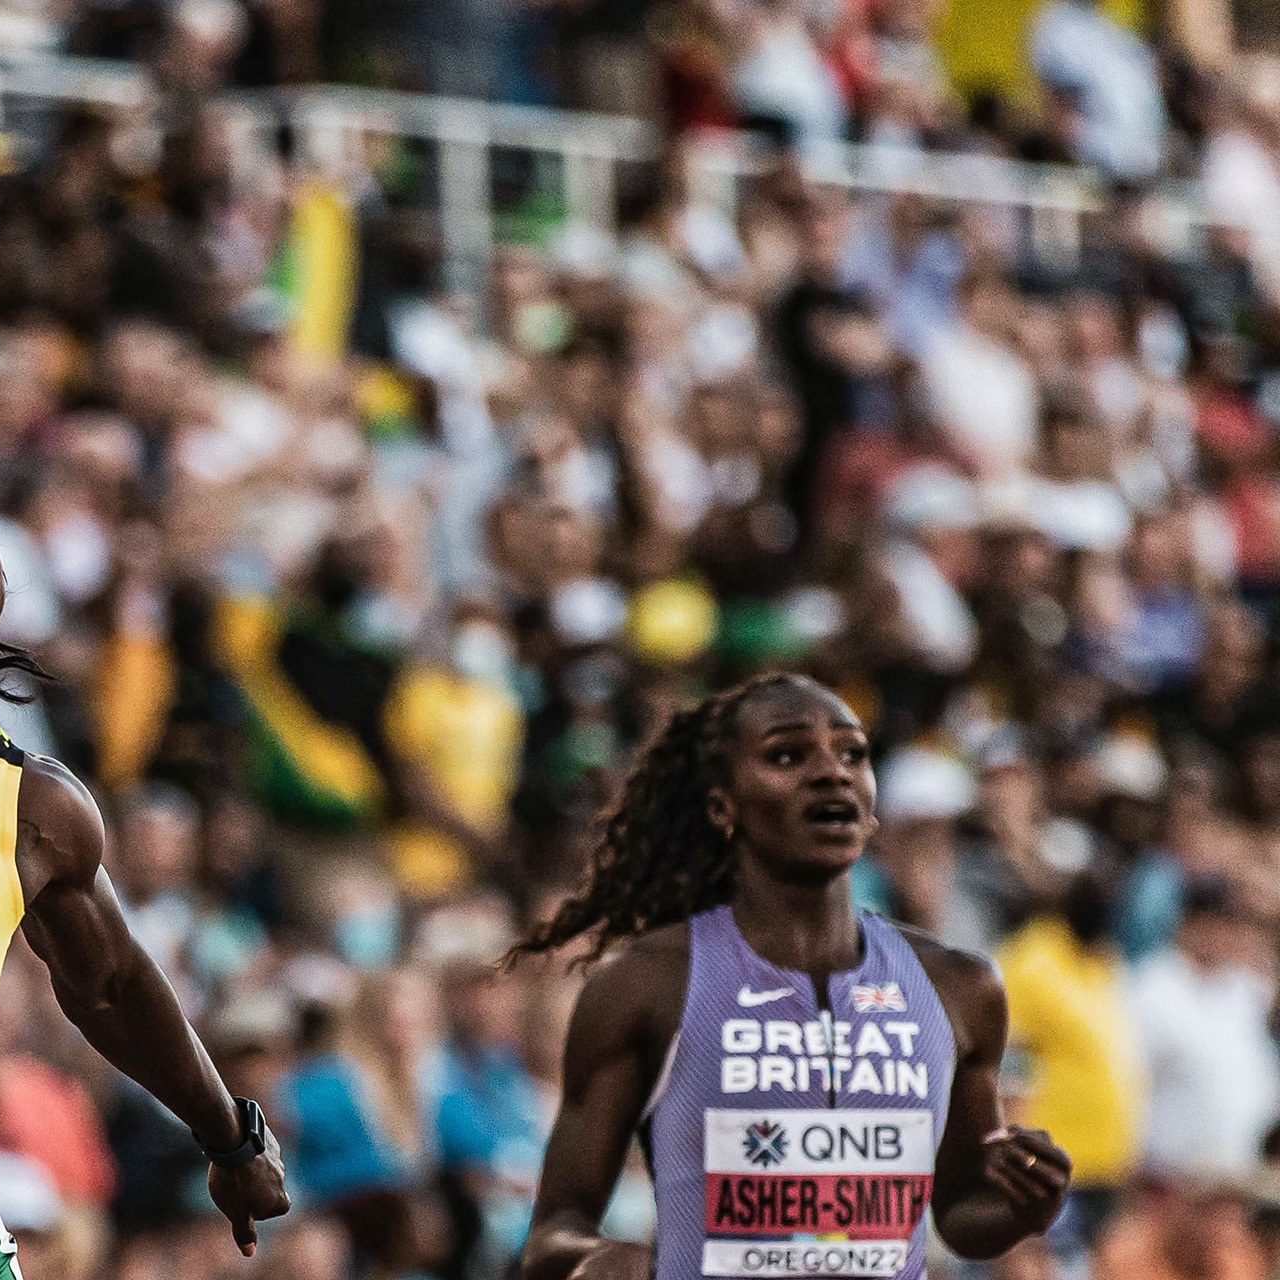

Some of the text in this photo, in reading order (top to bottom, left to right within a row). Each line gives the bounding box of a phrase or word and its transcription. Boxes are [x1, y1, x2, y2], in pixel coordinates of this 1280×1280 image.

[721, 1018, 920, 1057] GREAT
[721, 1055, 929, 1100] BRITAIN
[800, 1124, 903, 1163] QNB
[714, 1177, 926, 1227] ASHER-SMITH
